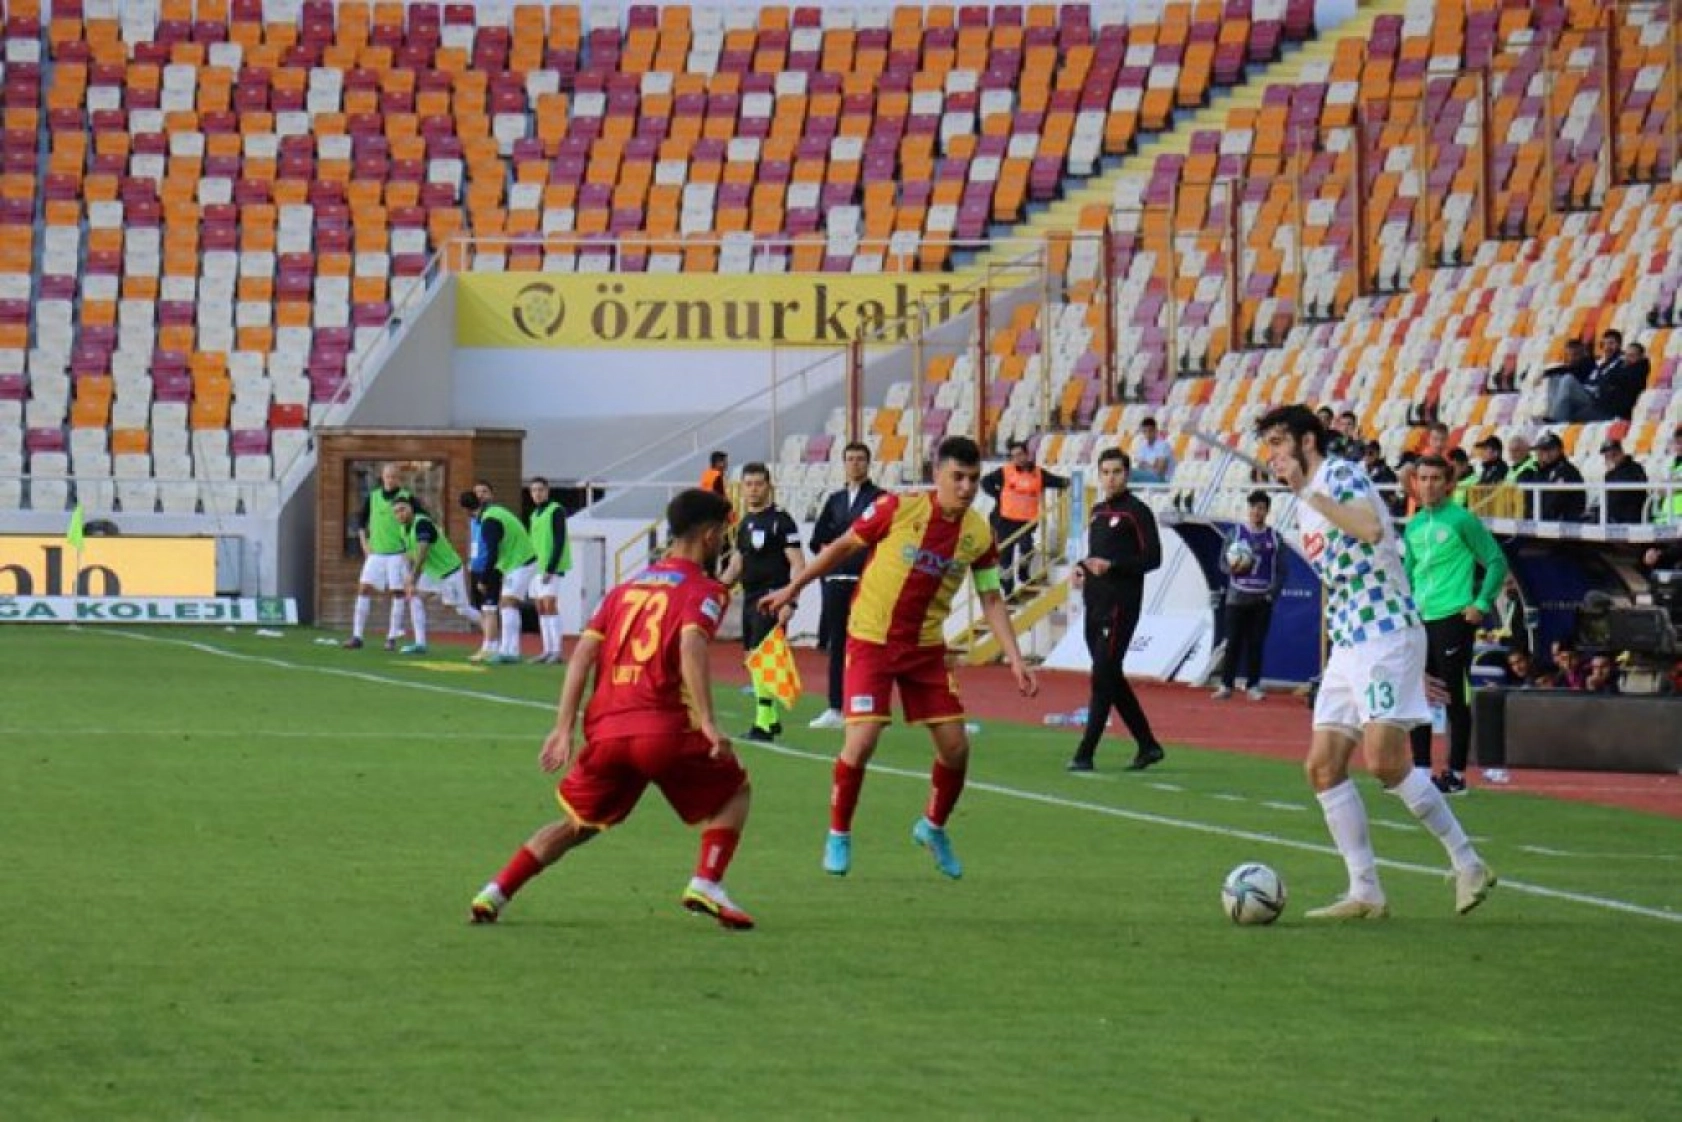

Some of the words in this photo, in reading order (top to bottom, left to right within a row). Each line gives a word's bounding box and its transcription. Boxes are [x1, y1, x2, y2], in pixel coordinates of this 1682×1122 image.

[590, 282, 800, 342] öznur
[622, 588, 669, 662] 73
[1365, 681, 1395, 710] 13
